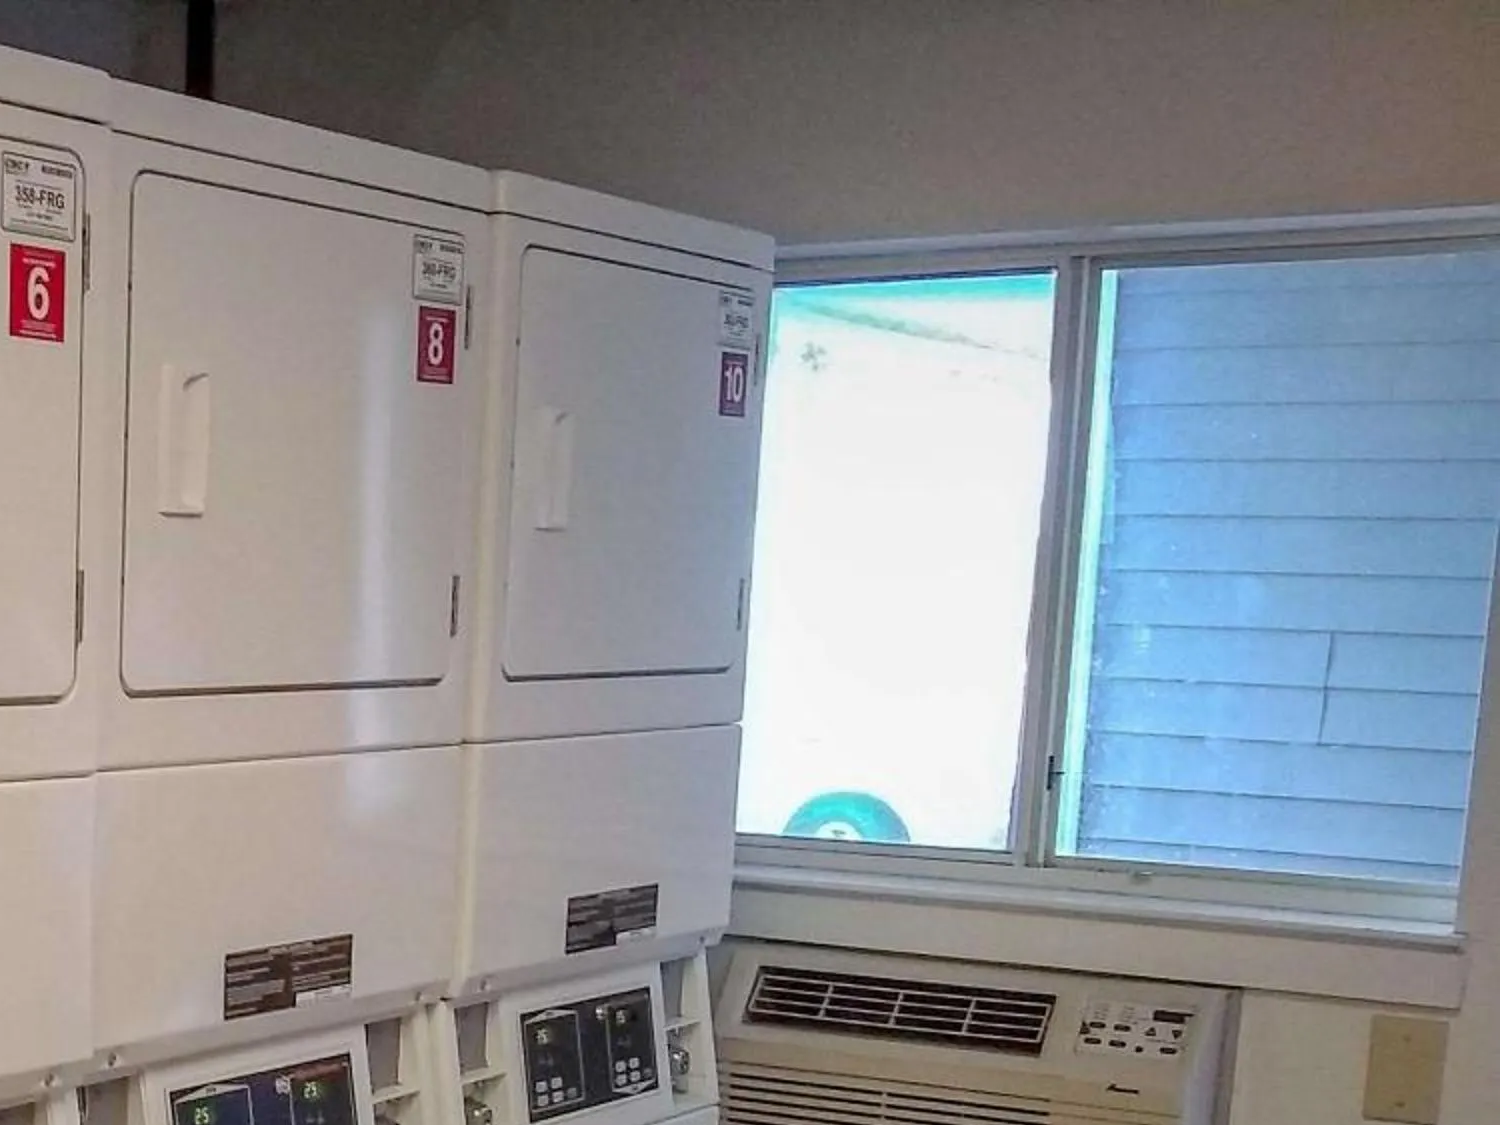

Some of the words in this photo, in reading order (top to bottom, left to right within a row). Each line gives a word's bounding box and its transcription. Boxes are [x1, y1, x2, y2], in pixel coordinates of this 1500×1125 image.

[27, 266, 50, 320] 6
[428, 322, 444, 366] 8
[724, 365, 744, 402] 10
